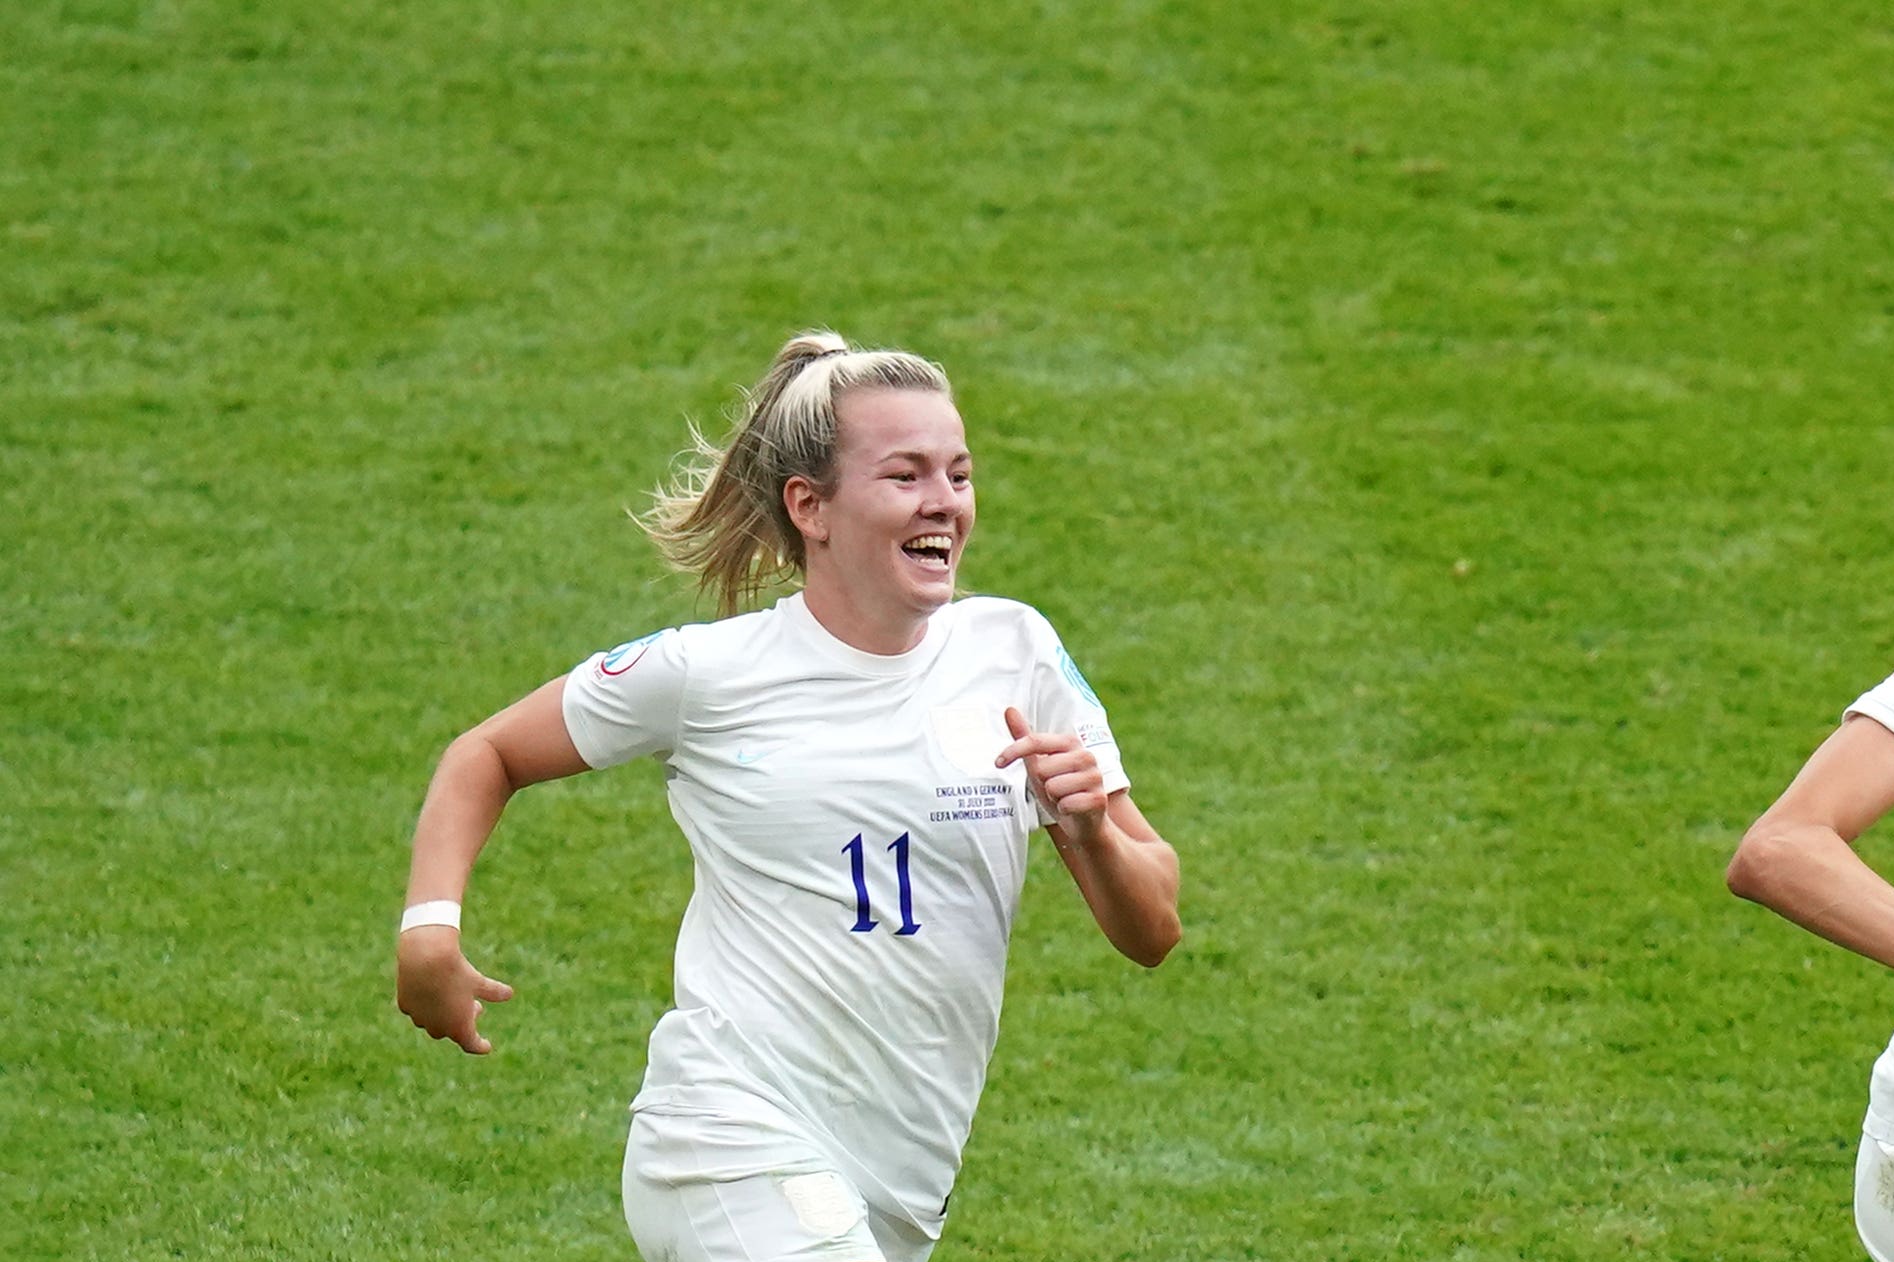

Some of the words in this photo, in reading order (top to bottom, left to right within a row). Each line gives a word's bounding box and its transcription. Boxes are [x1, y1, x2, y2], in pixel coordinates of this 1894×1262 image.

[936, 786, 973, 798] ENGLAND
[980, 785, 1013, 796] GERMANY
[929, 811, 951, 822] UEFA
[951, 809, 983, 821] WOMENS
[841, 831, 922, 935] 11
